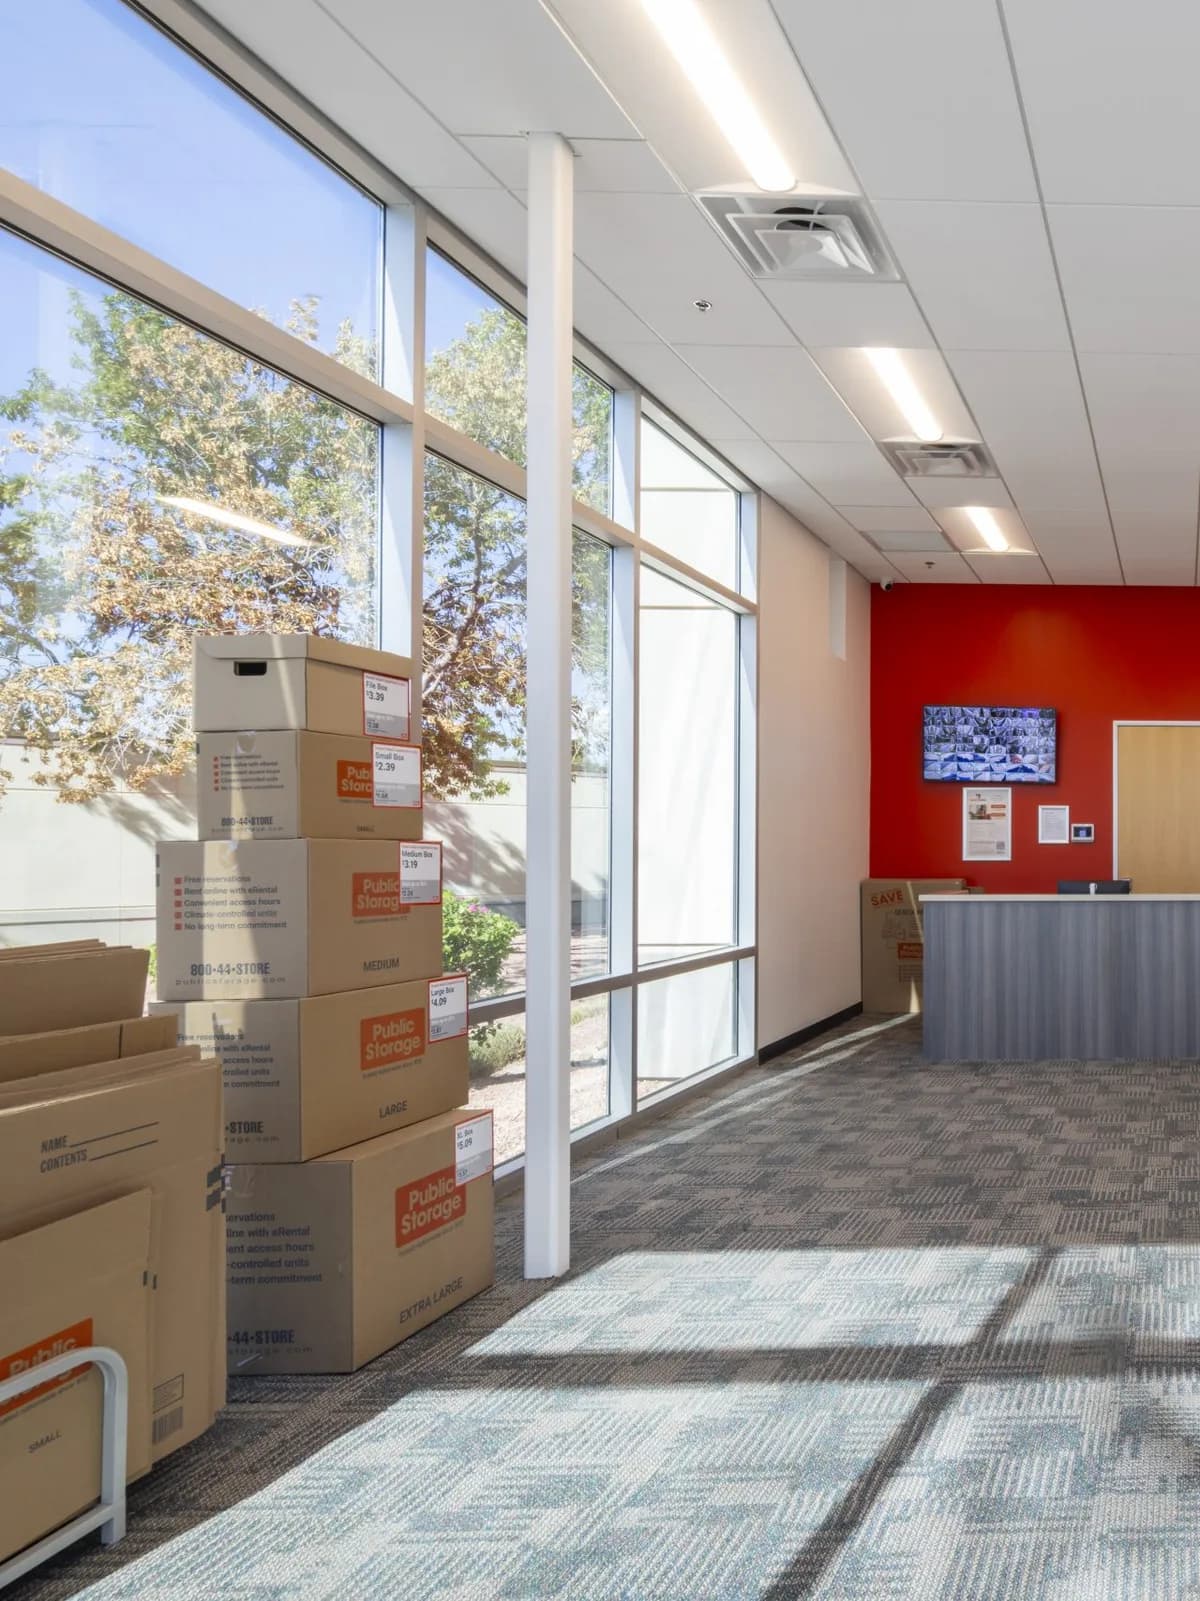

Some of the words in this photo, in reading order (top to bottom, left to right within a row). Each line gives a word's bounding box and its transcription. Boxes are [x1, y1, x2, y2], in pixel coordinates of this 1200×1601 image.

[347, 765, 371, 780] Pub
[375, 761, 396, 772] $2.39
[357, 894, 399, 911] Storag
[871, 889, 903, 906] SAVE
[363, 957, 400, 973] MEDIUM
[372, 1018, 416, 1041] Public
[365, 1035, 422, 1061] Storage
[378, 1100, 408, 1119] LARGE
[41, 1135, 68, 1153] NAME
[40, 1148, 88, 1174] CONTENTS
[408, 1177, 455, 1210] Public
[401, 1193, 463, 1236] Storage
[227, 1228, 245, 1239] line
[248, 1228, 270, 1238] with
[286, 1243, 315, 1253] hours
[227, 1258, 282, 1270] -controlled
[228, 1275, 256, 1285] -term
[400, 1297, 432, 1324] EXTRA
[433, 1277, 464, 1304] LARGE
[28, 1428, 62, 1454] SMALL
